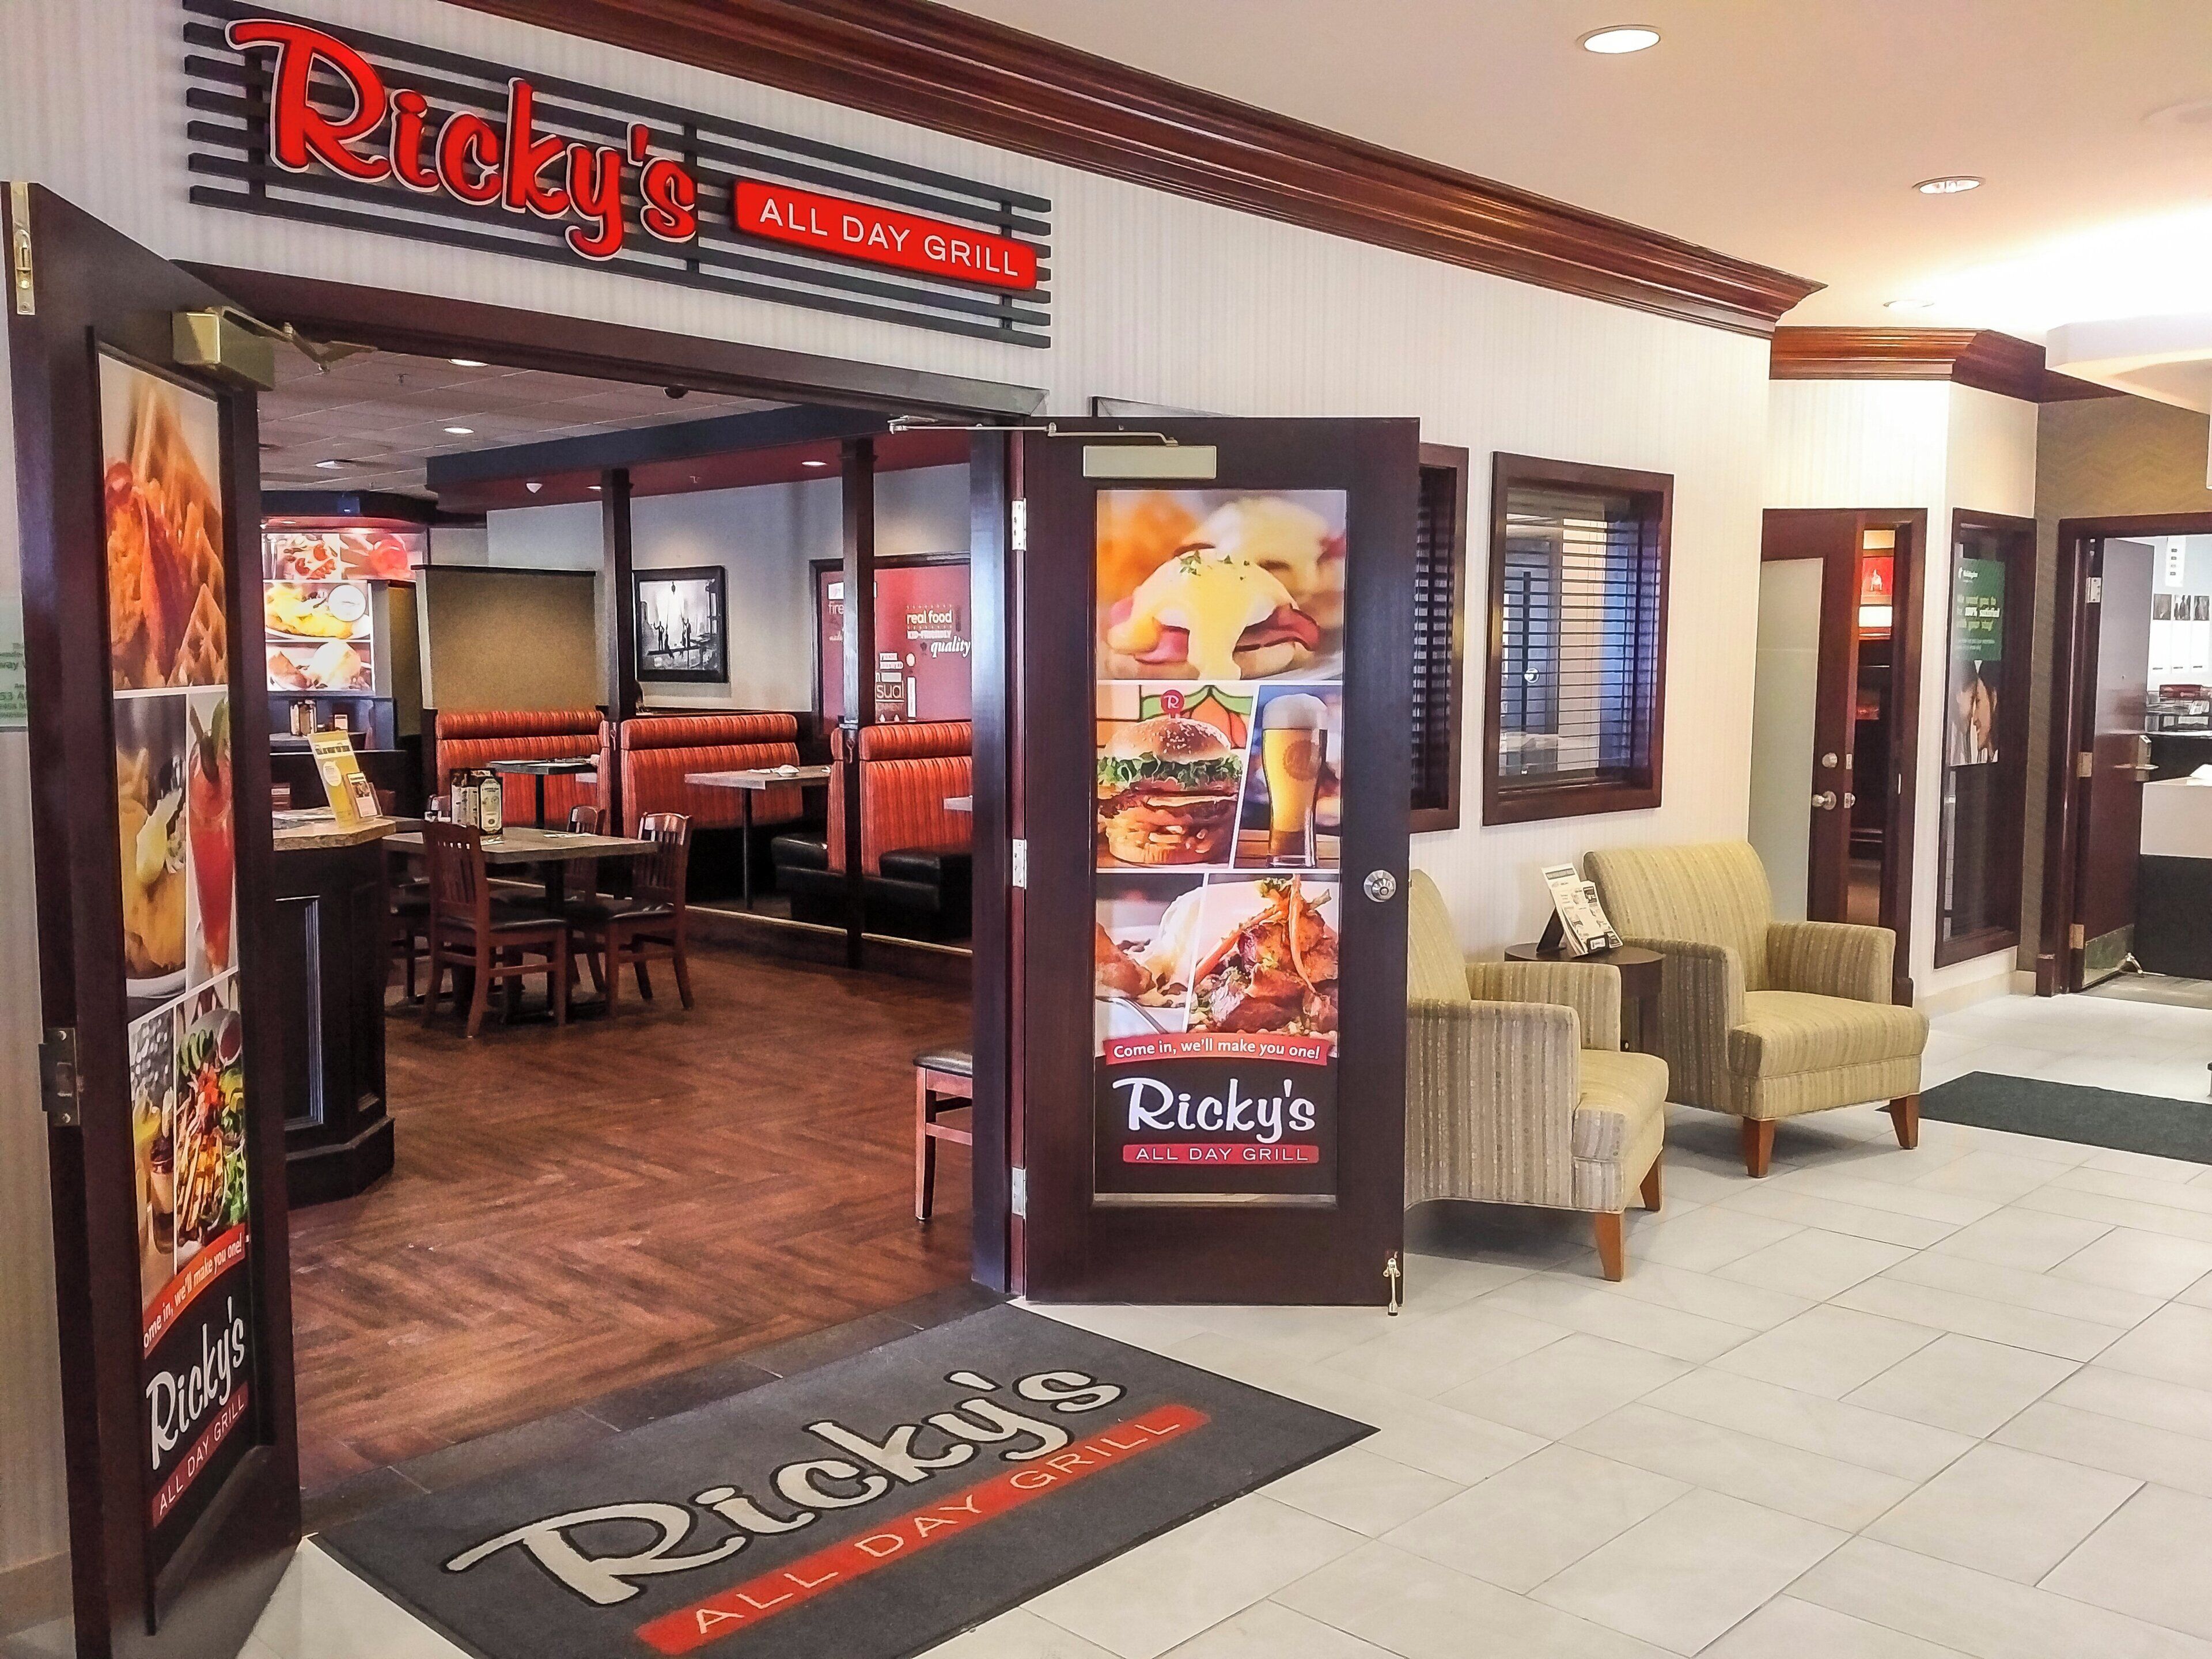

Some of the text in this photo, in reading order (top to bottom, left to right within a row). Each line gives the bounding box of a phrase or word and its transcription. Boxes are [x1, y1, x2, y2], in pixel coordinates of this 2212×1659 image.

[225, 18, 696, 259] Ricky's
[759, 198, 1018, 276] ALL DAY GRILL
[906, 609, 952, 624] real food
[930, 635, 971, 658] quality
[876, 680, 904, 699] sual
[1113, 1038, 1321, 1060] Come in, we'll make you one!
[1112, 1077, 1316, 1143] Ricky's
[1136, 1148, 1308, 1161] ALL DAY GRILL
[143, 1232, 243, 1348] ome in, we'll make you one!
[146, 1296, 245, 1470] Ricky's
[160, 1394, 244, 1516] ALL DAY GRILL
[445, 1369, 1124, 1604] Ricky's
[694, 1423, 1181, 1635] ALL DAY GRILL
